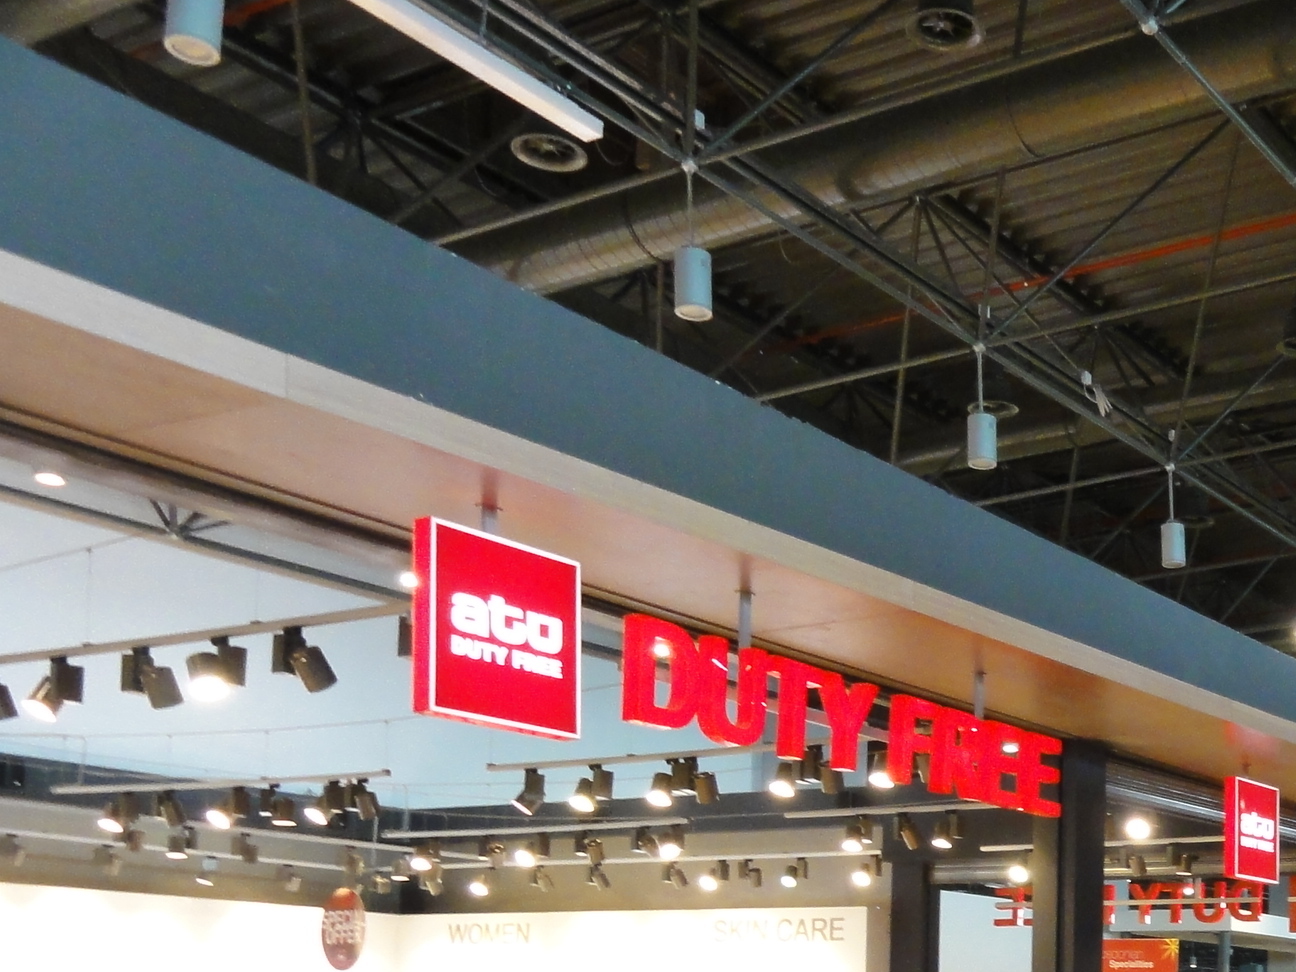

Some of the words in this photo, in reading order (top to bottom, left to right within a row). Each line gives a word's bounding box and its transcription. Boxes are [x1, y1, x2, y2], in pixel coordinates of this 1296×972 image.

[450, 592, 563, 655] ato
[450, 634, 509, 666] DUTY
[511, 649, 564, 680] FREE
[622, 613, 879, 772] DUTY
[887, 694, 1063, 818] FREE
[448, 922, 531, 944] WOMEN
[713, 919, 769, 942] SKIN
[777, 917, 845, 941] CARE
